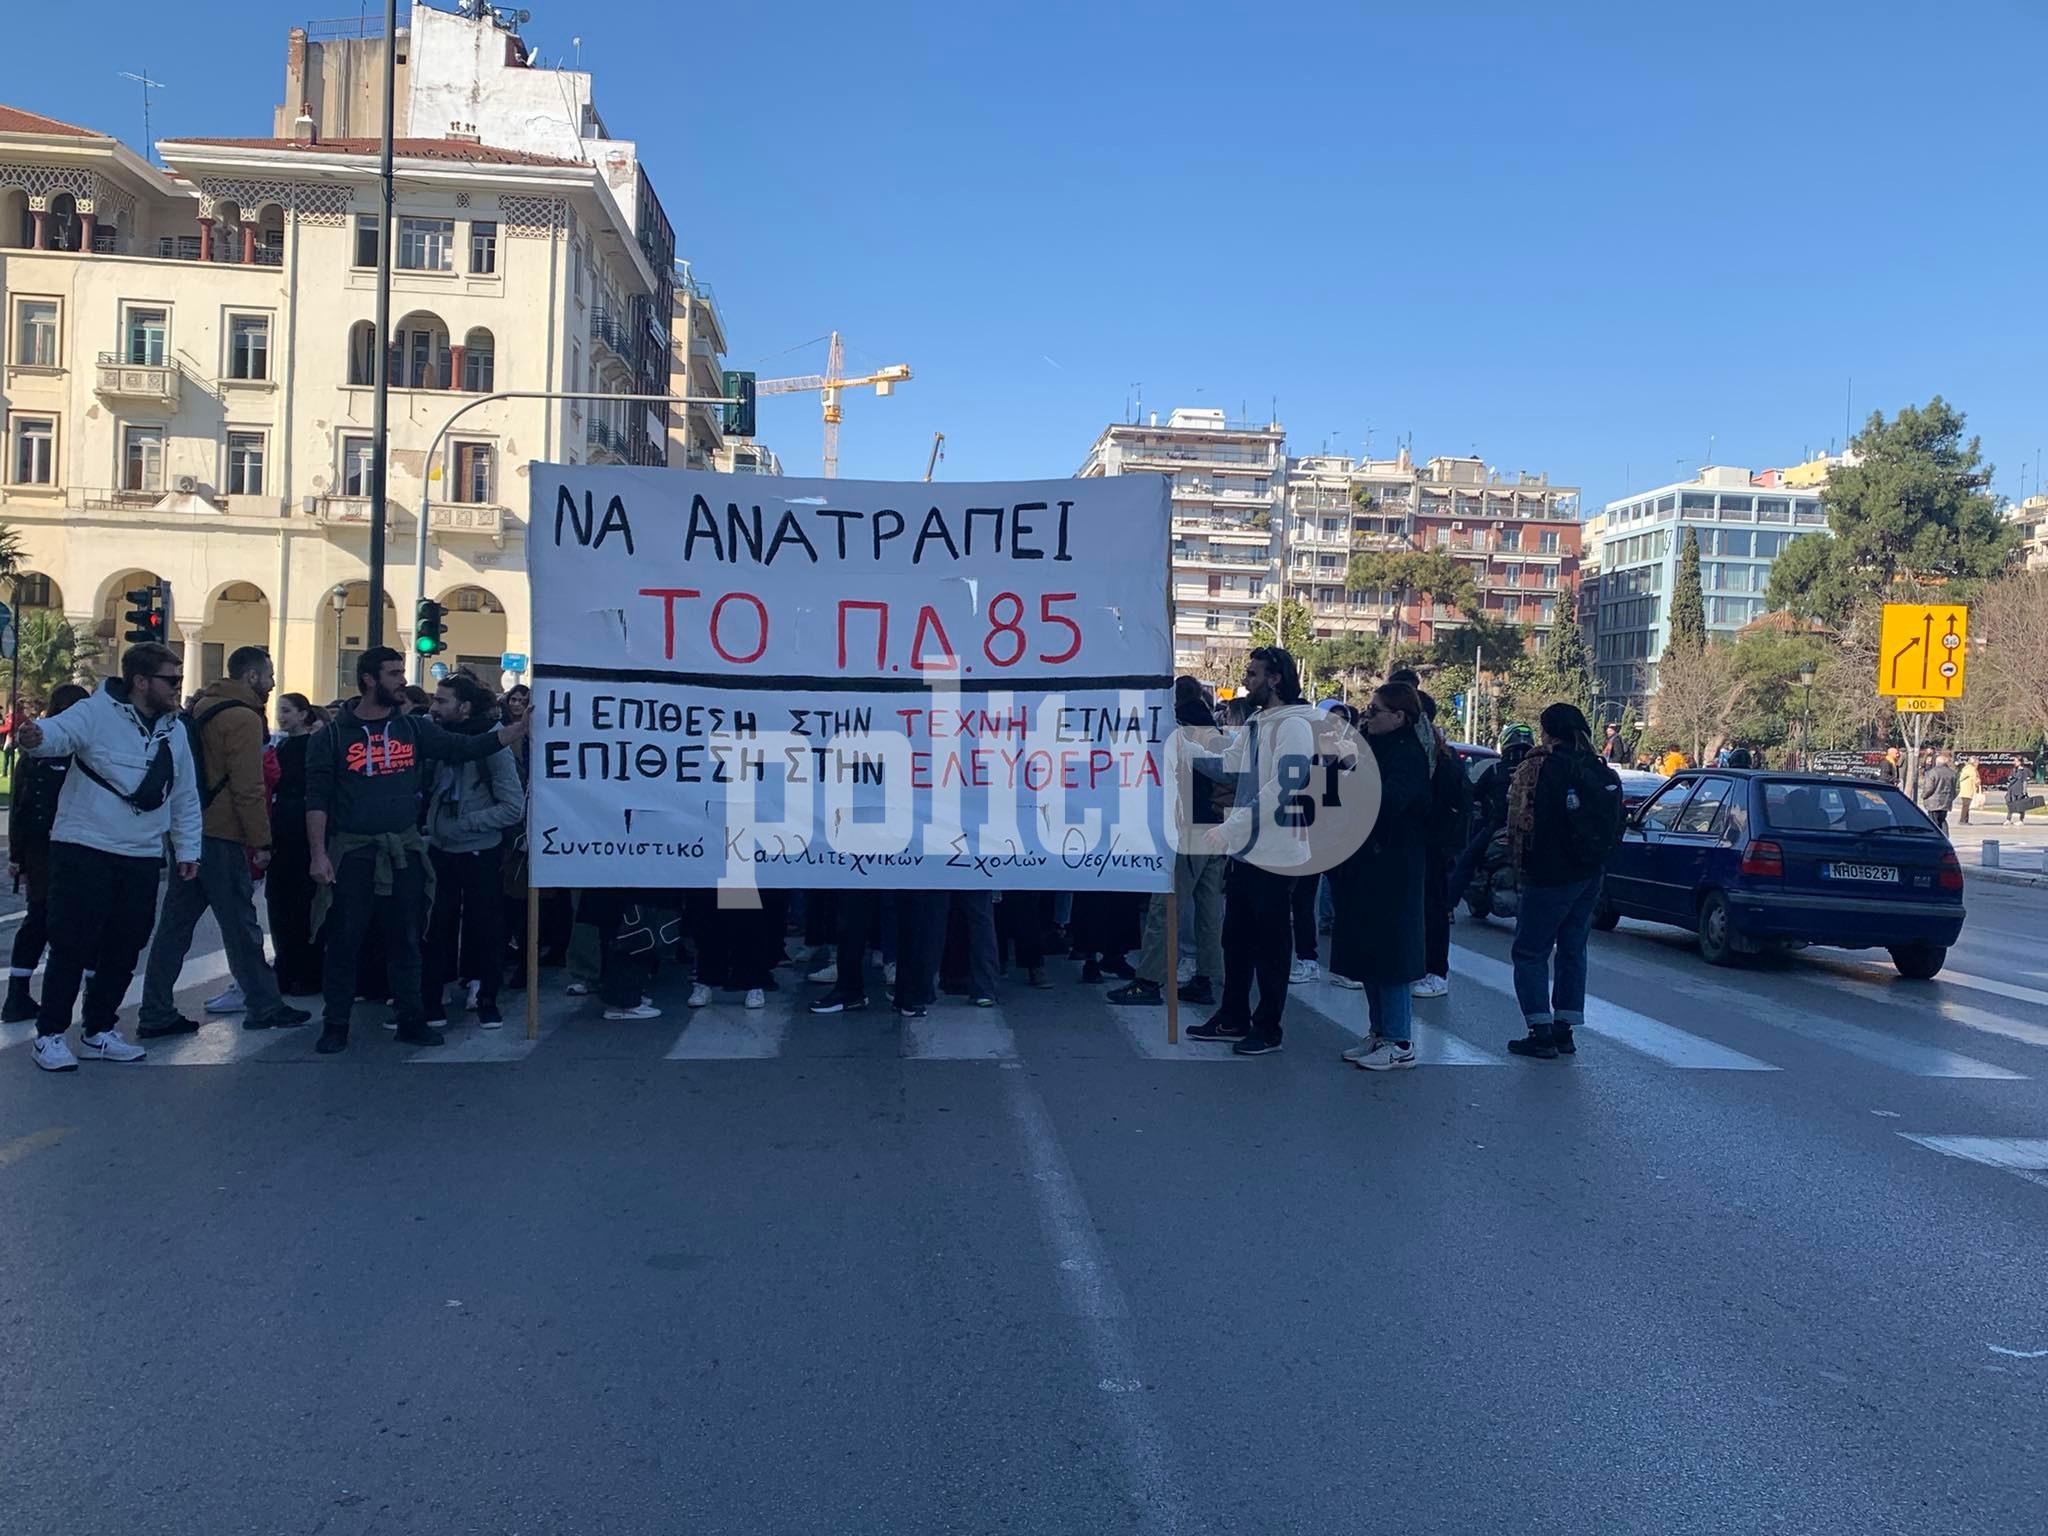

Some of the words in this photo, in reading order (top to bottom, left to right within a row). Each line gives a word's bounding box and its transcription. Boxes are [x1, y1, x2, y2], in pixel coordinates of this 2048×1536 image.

[555, 485, 633, 555] ΝΑ
[684, 493, 1075, 566] ΑΝΑΤΡΑΠΕΙ
[638, 587, 769, 664] ΤΟ
[548, 690, 571, 728] Η
[592, 695, 757, 740] ΕΠΙΘΕΣΗ
[788, 706, 872, 738] ΣΤΗΝ
[896, 705, 1027, 741] ΤΕΧΝΗ
[1055, 706, 1163, 744] ΕΙΝΑΙ
[545, 741, 765, 783] ΕΠΙΘΕΣΗ
[784, 746, 884, 785] ΣΤΗΝ
[910, 748, 1163, 791] ΕΛΕΥΘΕΡΙΑ
[541, 826, 705, 859] Συντονιστικό
[725, 826, 925, 876] Καλλιτεχνικών
[946, 833, 1047, 878] Σχολών
